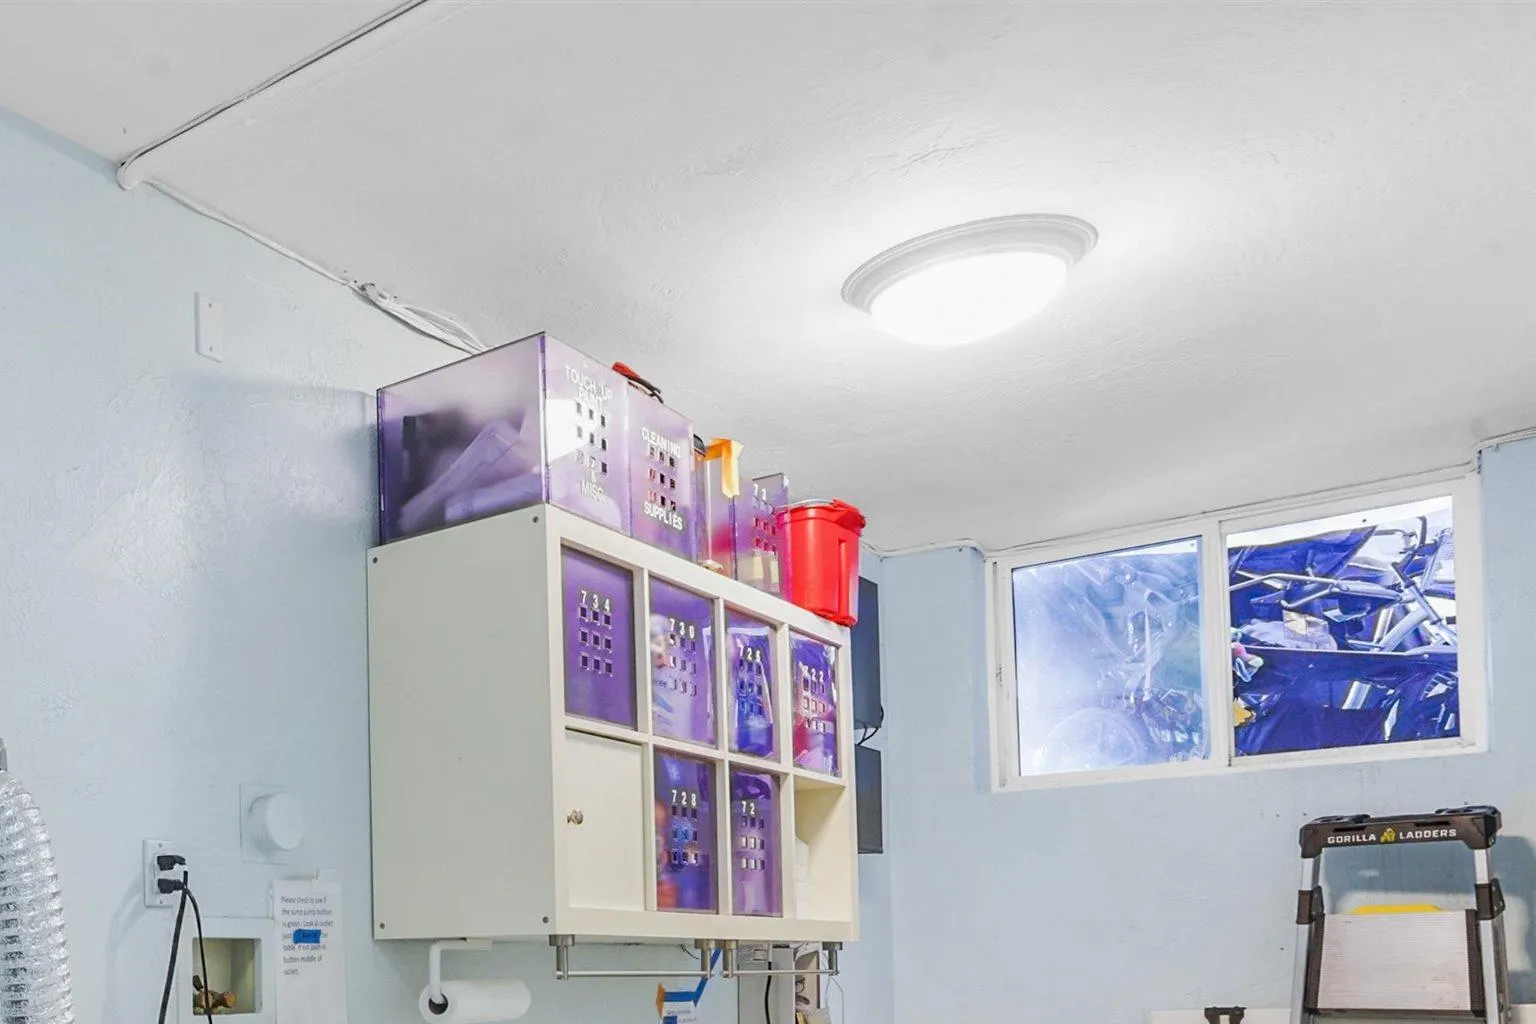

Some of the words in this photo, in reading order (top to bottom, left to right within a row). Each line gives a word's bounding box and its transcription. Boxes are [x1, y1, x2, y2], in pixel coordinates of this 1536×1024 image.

[641, 427, 681, 458] CLEANING
[643, 501, 683, 530] SUPPLIES
[672, 790, 696, 806] 728
[1328, 834, 1376, 843] GORILLA
[1399, 829, 1457, 840] LADDERS
